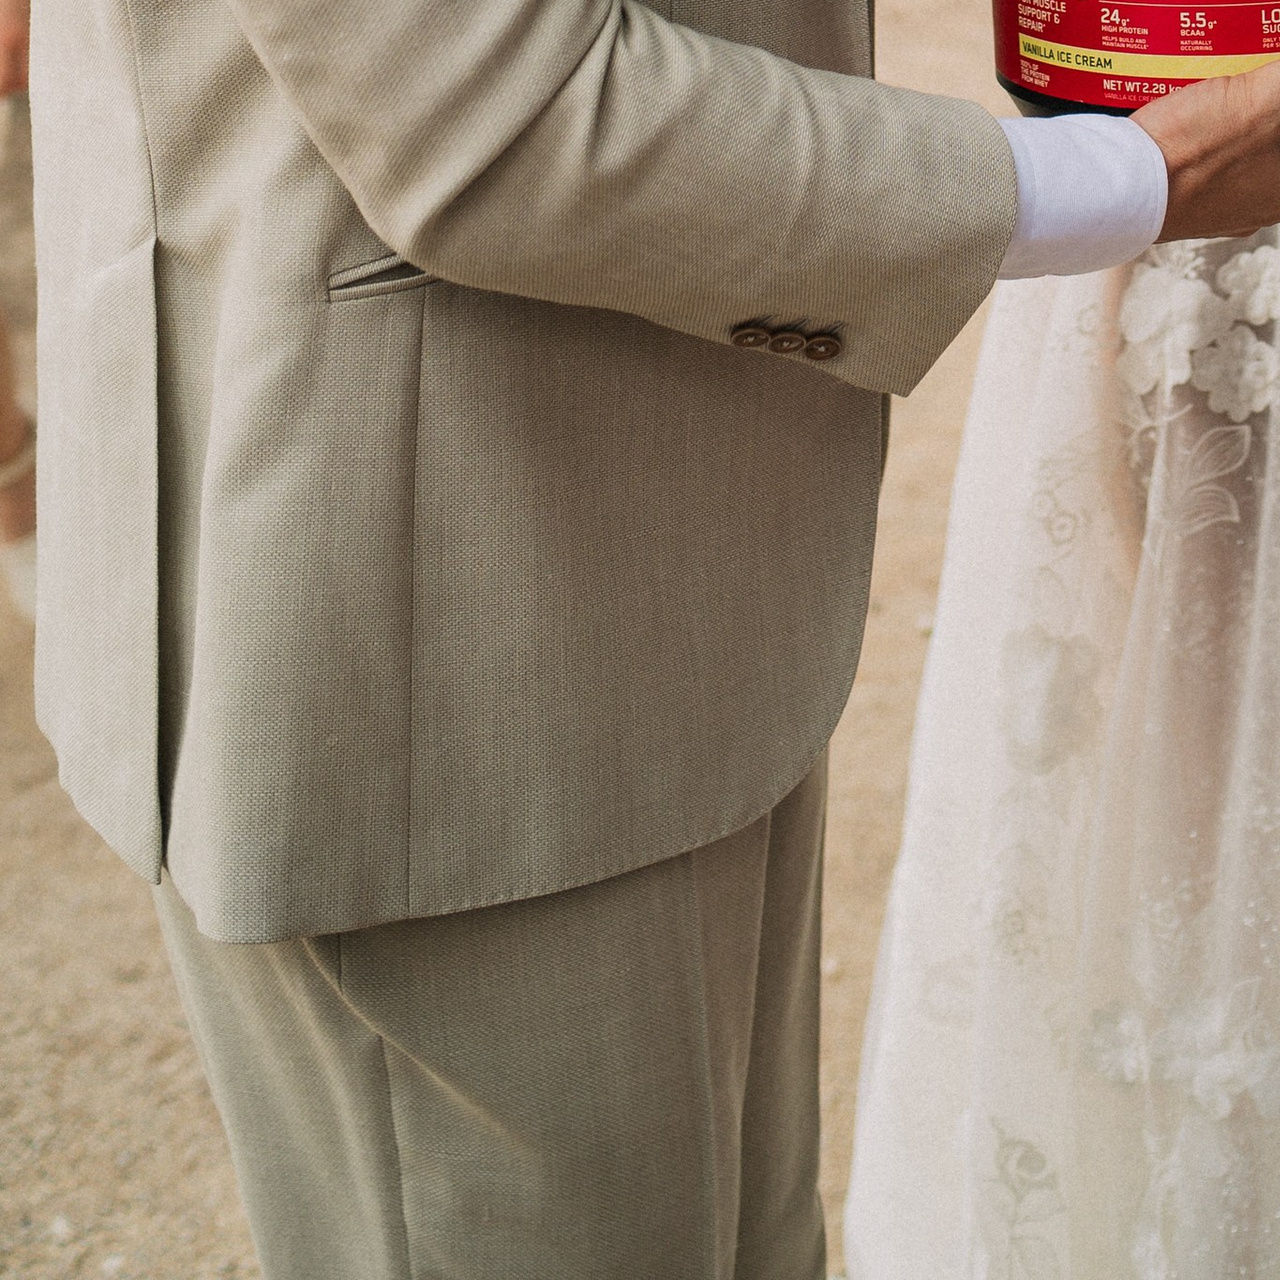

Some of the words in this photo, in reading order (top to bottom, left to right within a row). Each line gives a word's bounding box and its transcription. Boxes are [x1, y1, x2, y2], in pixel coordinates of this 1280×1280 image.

[1018, 4, 1052, 22] SUPPORT
[1053, 13, 1060, 25] &
[1102, 25, 1117, 33] HIGH
[1118, 27, 1148, 36] PROTEIN
[1180, 29, 1205, 37] BCAAs
[1022, 40, 1055, 61] VANILLA
[1056, 50, 1072, 64] ICE
[1074, 53, 1112, 70] CREAM
[1103, 79, 1123, 91] NET
[1124, 81, 1141, 93] WT
[1142, 83, 1166, 94] 2.28
